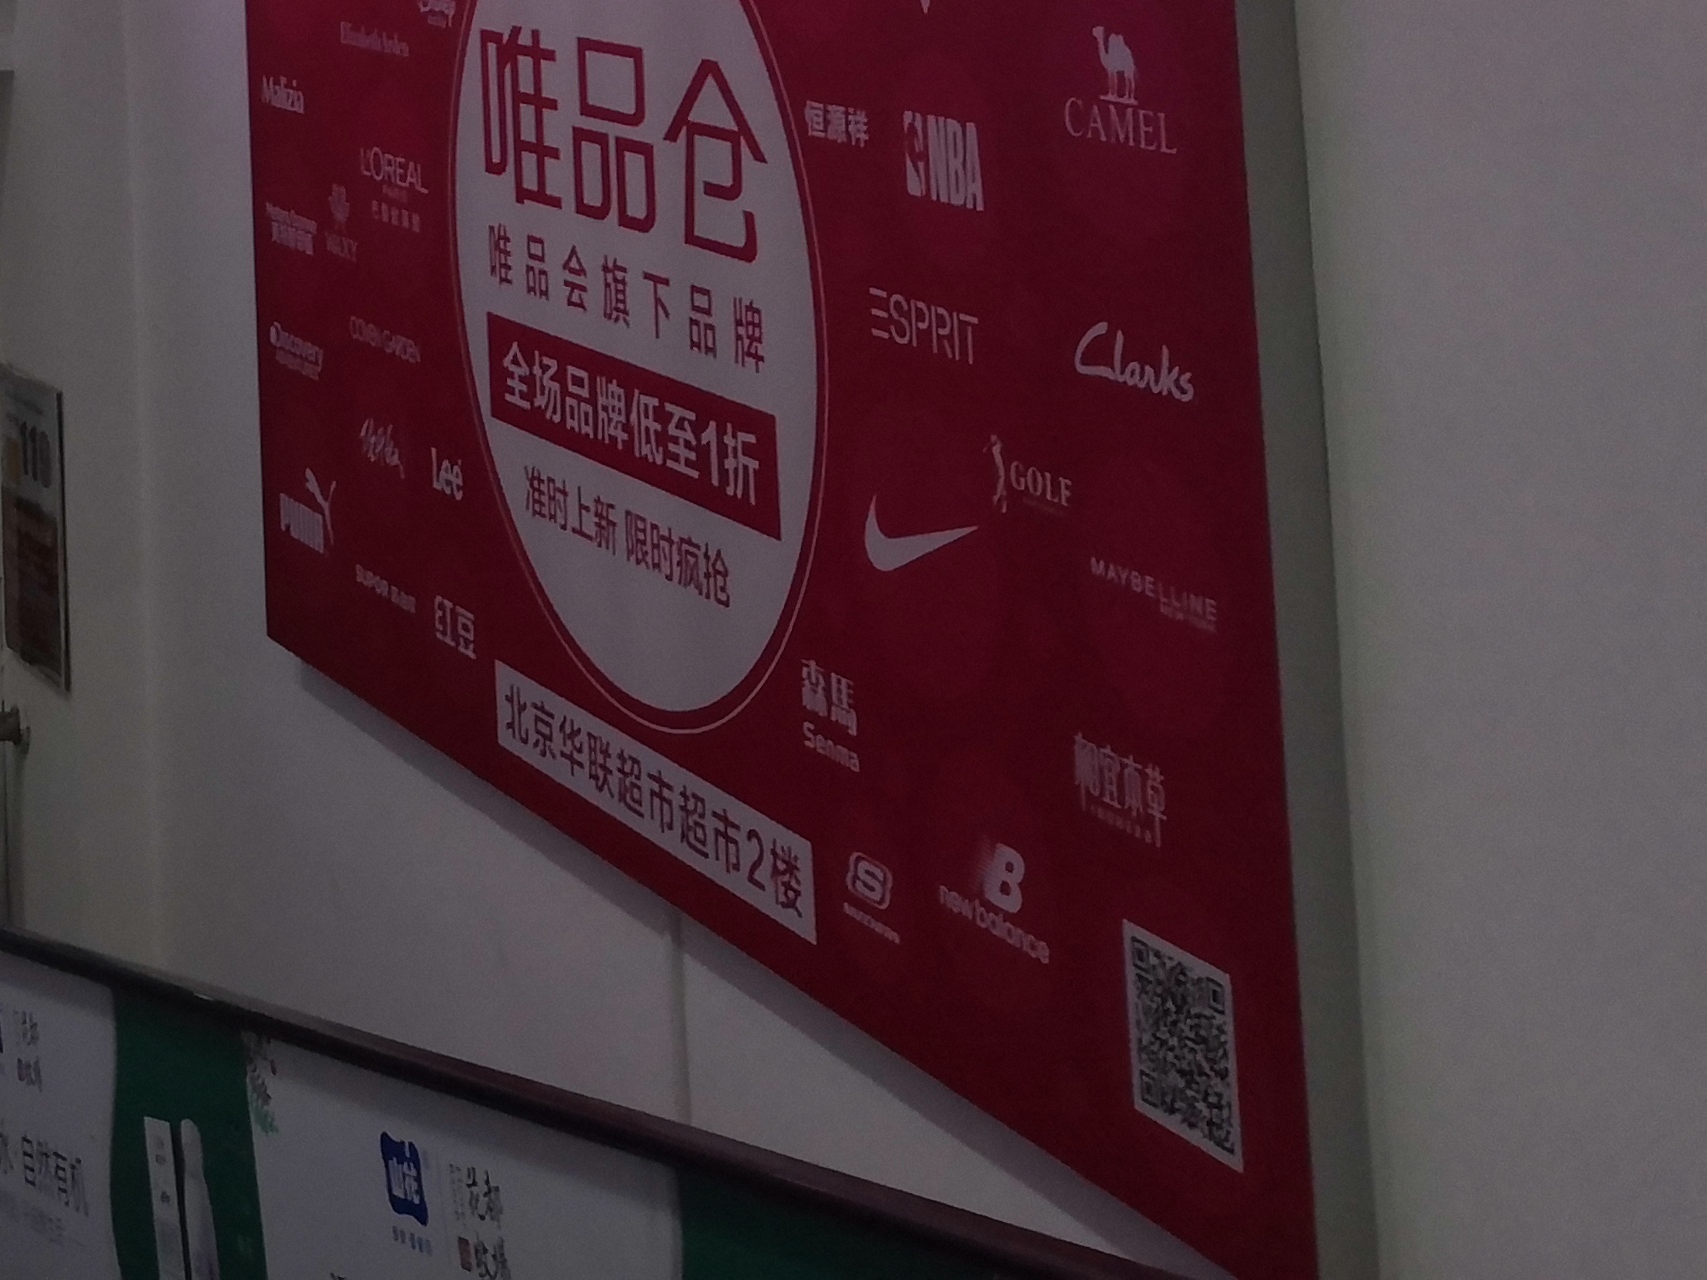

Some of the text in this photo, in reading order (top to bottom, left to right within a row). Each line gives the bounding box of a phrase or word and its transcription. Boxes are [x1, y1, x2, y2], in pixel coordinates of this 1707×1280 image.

[480, 25, 768, 263] 唯品仓
[804, 99, 870, 148] 恒源祥
[926, 113, 985, 213] NBA
[1063, 97, 1179, 156] CAMEL
[488, 222, 766, 374] 唯品会旗下品牌
[868, 286, 980, 366] ESPRIT
[1073, 320, 1196, 403] Clarks
[501, 340, 761, 507] 全场品牌低至1折
[430, 446, 464, 501] Lee
[1008, 458, 1073, 508] GOLF
[523, 465, 731, 609] 准时上新 限时疯抢
[434, 594, 478, 661] 红豆
[1090, 555, 1218, 623] MAYBELLINE
[504, 683, 803, 919] 北京华联超市超市2楼
